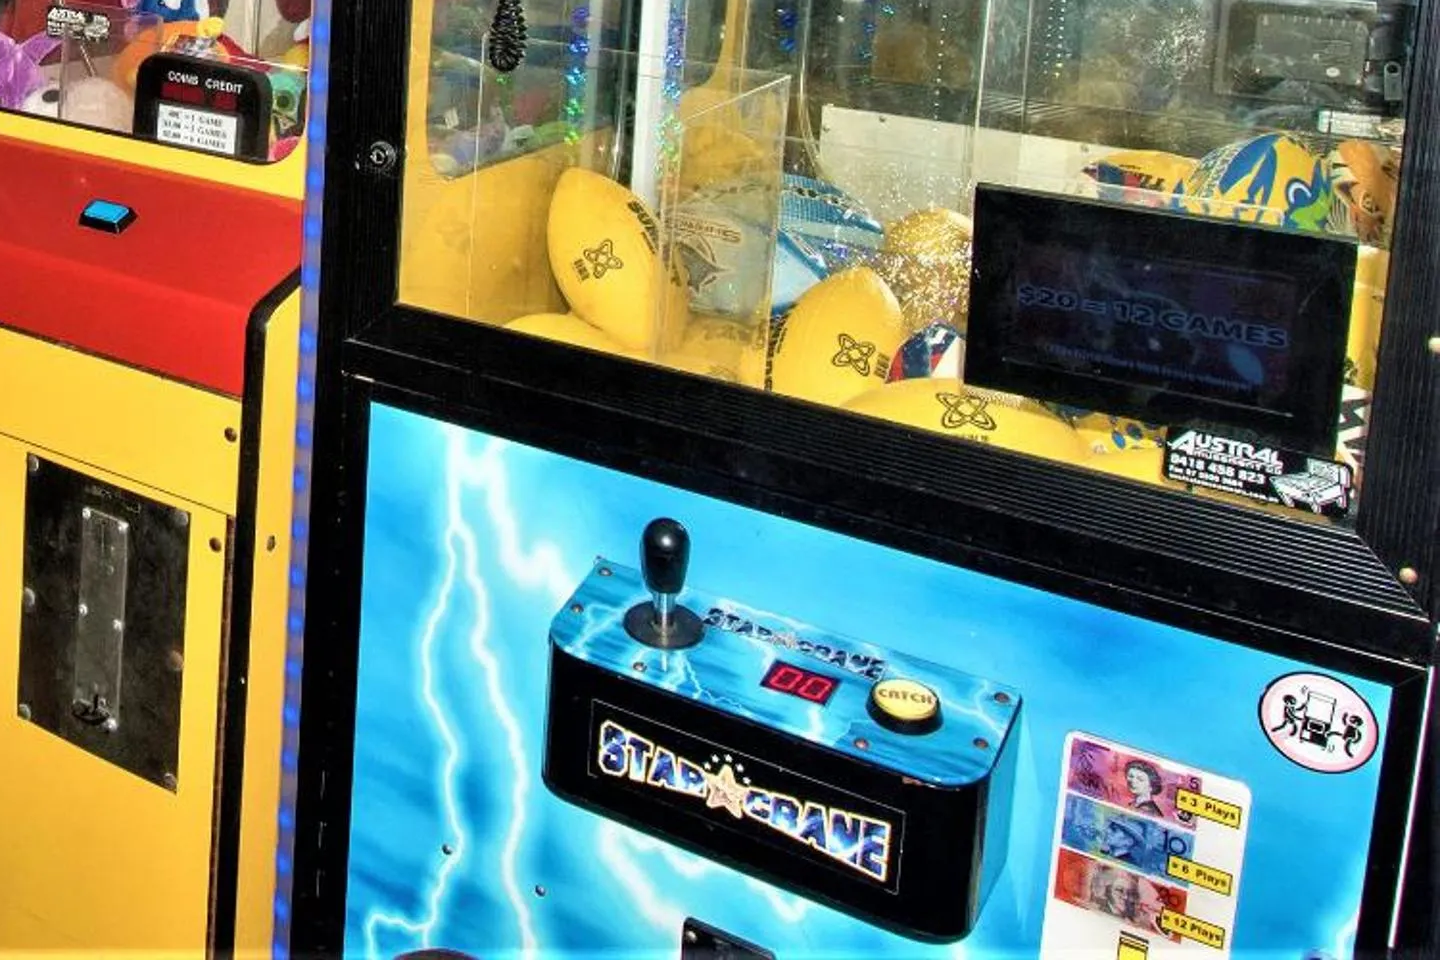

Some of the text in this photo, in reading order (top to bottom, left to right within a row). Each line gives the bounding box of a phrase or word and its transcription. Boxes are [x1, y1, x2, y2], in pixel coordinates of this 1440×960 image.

[168, 71, 244, 94] COINS CREDIT
[1112, 300, 1155, 327] 12
[1159, 308, 1290, 349] GAMES
[1167, 430, 1283, 465] AUSTRAL
[796, 639, 889, 682] CRANE
[769, 665, 832, 700] 00
[878, 688, 934, 705] CATCH
[598, 720, 892, 883] STAR CRANE
[1204, 800, 1237, 821] Plays
[1163, 829, 1188, 855] 10
[1195, 867, 1228, 888] Plays
[1190, 922, 1221, 942] Plays
